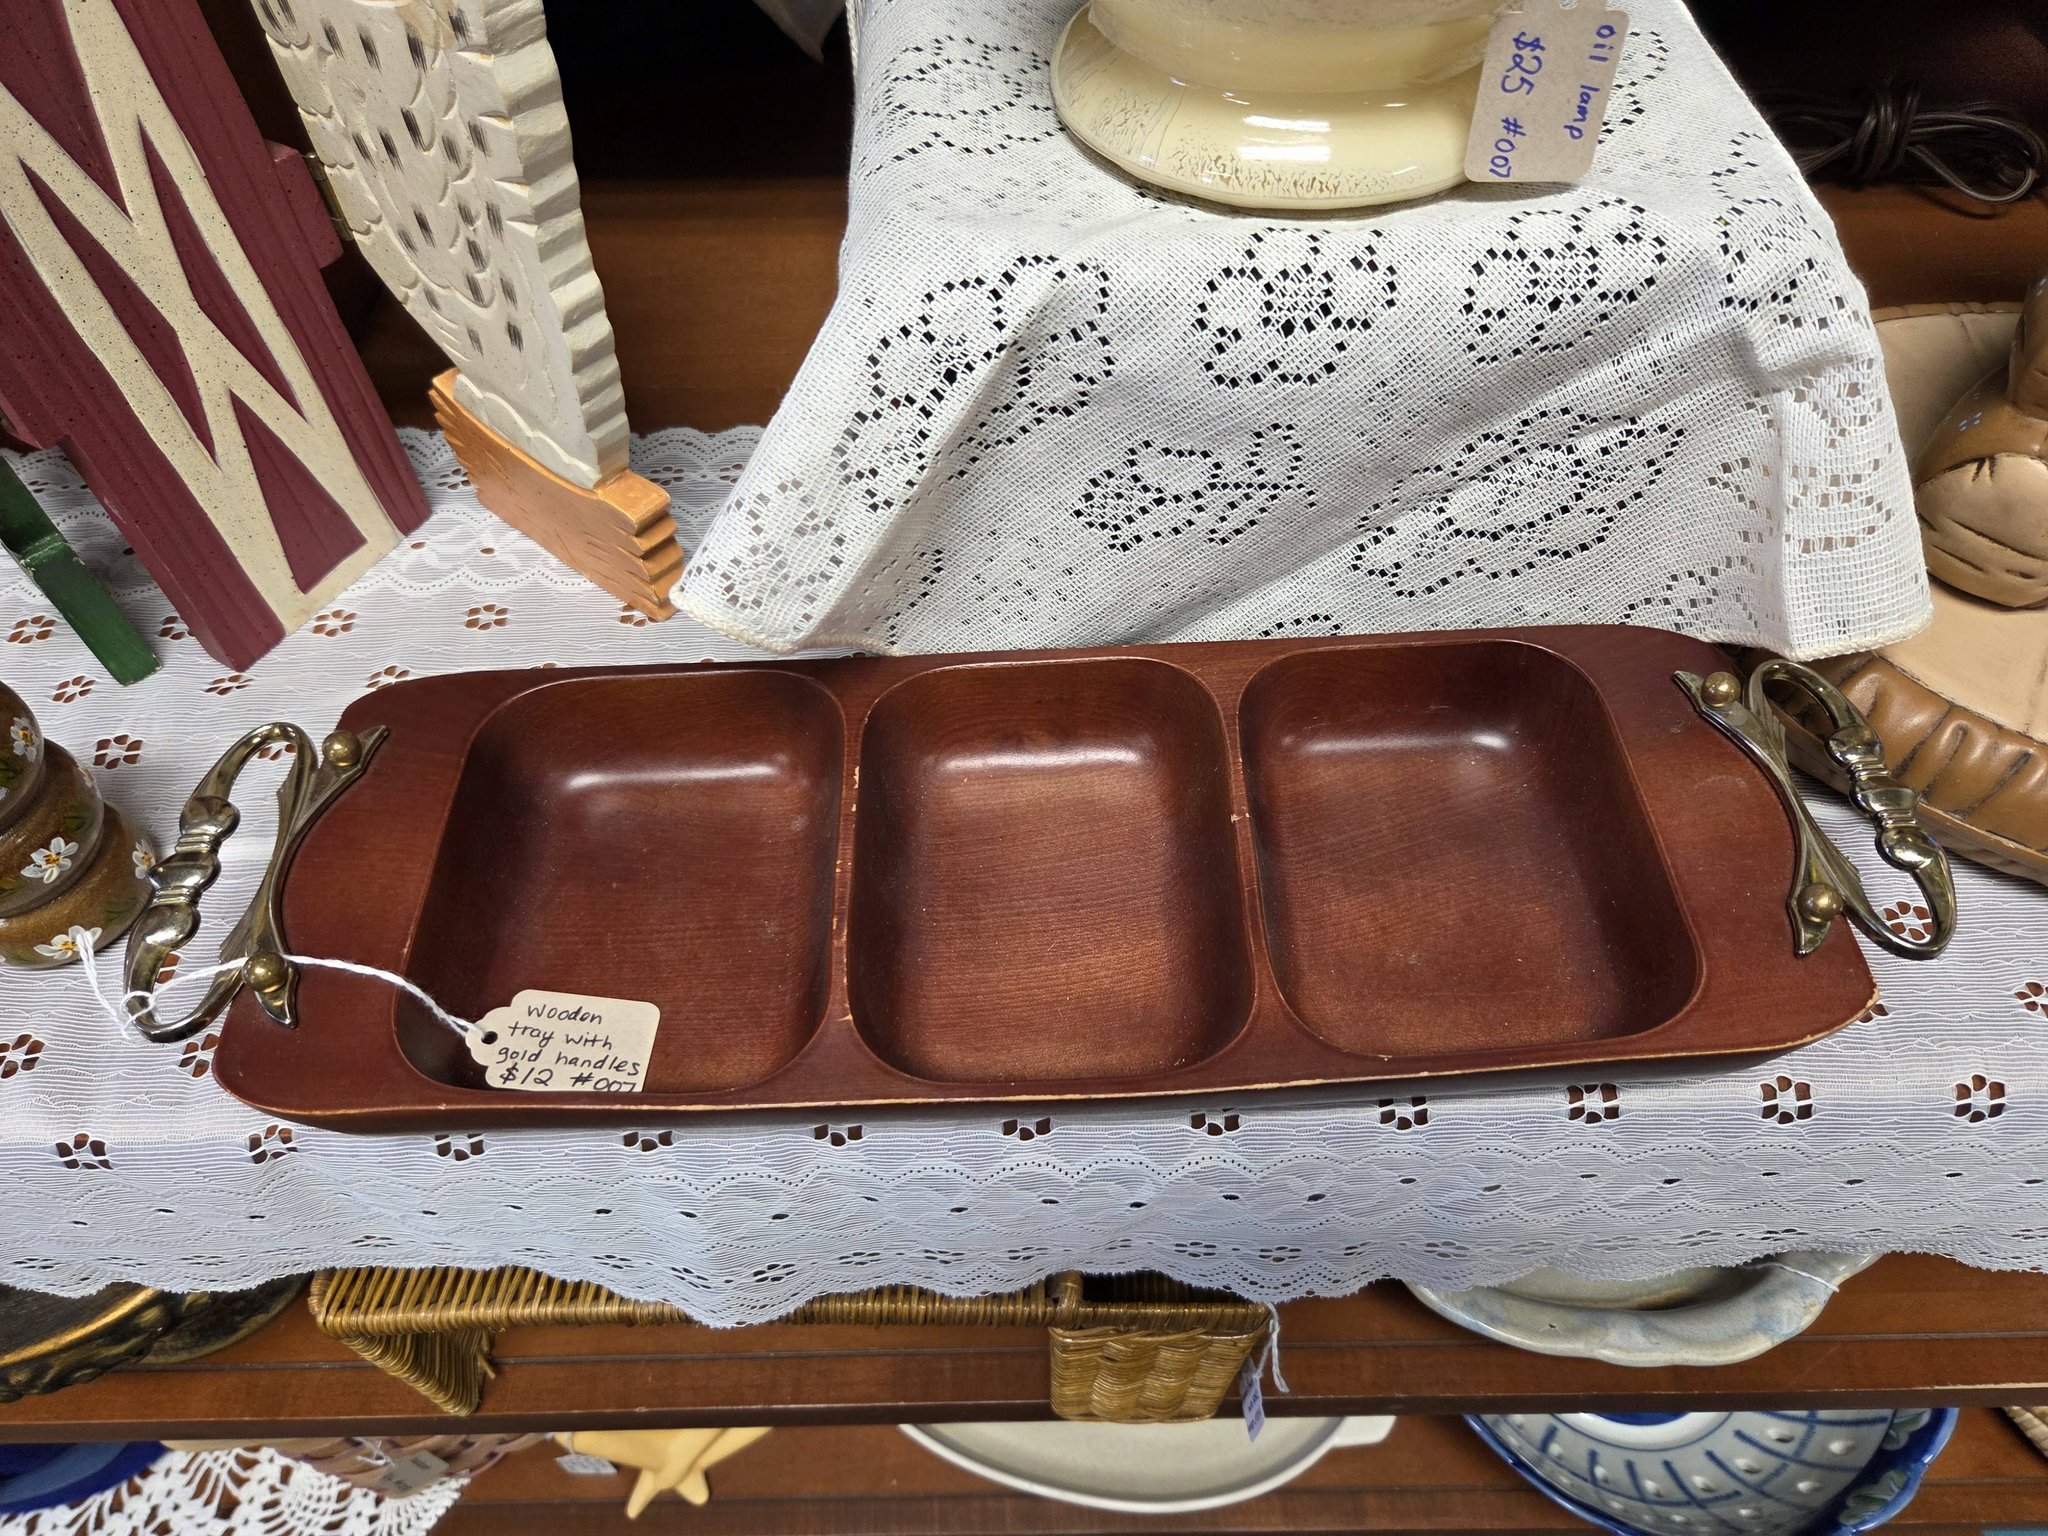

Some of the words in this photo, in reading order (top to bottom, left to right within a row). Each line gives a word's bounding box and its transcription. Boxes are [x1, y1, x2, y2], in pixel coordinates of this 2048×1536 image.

[1501, 31, 1545, 95] $25
[1563, 84, 1600, 140] lamp
[1489, 117, 1526, 178] #007
[508, 1021, 555, 1048] tray
[565, 1032, 612, 1051] with
[496, 1047, 543, 1064] gold
[555, 1051, 641, 1077] handles
[499, 1062, 554, 1087] $12
[569, 1072, 637, 1093] #007
